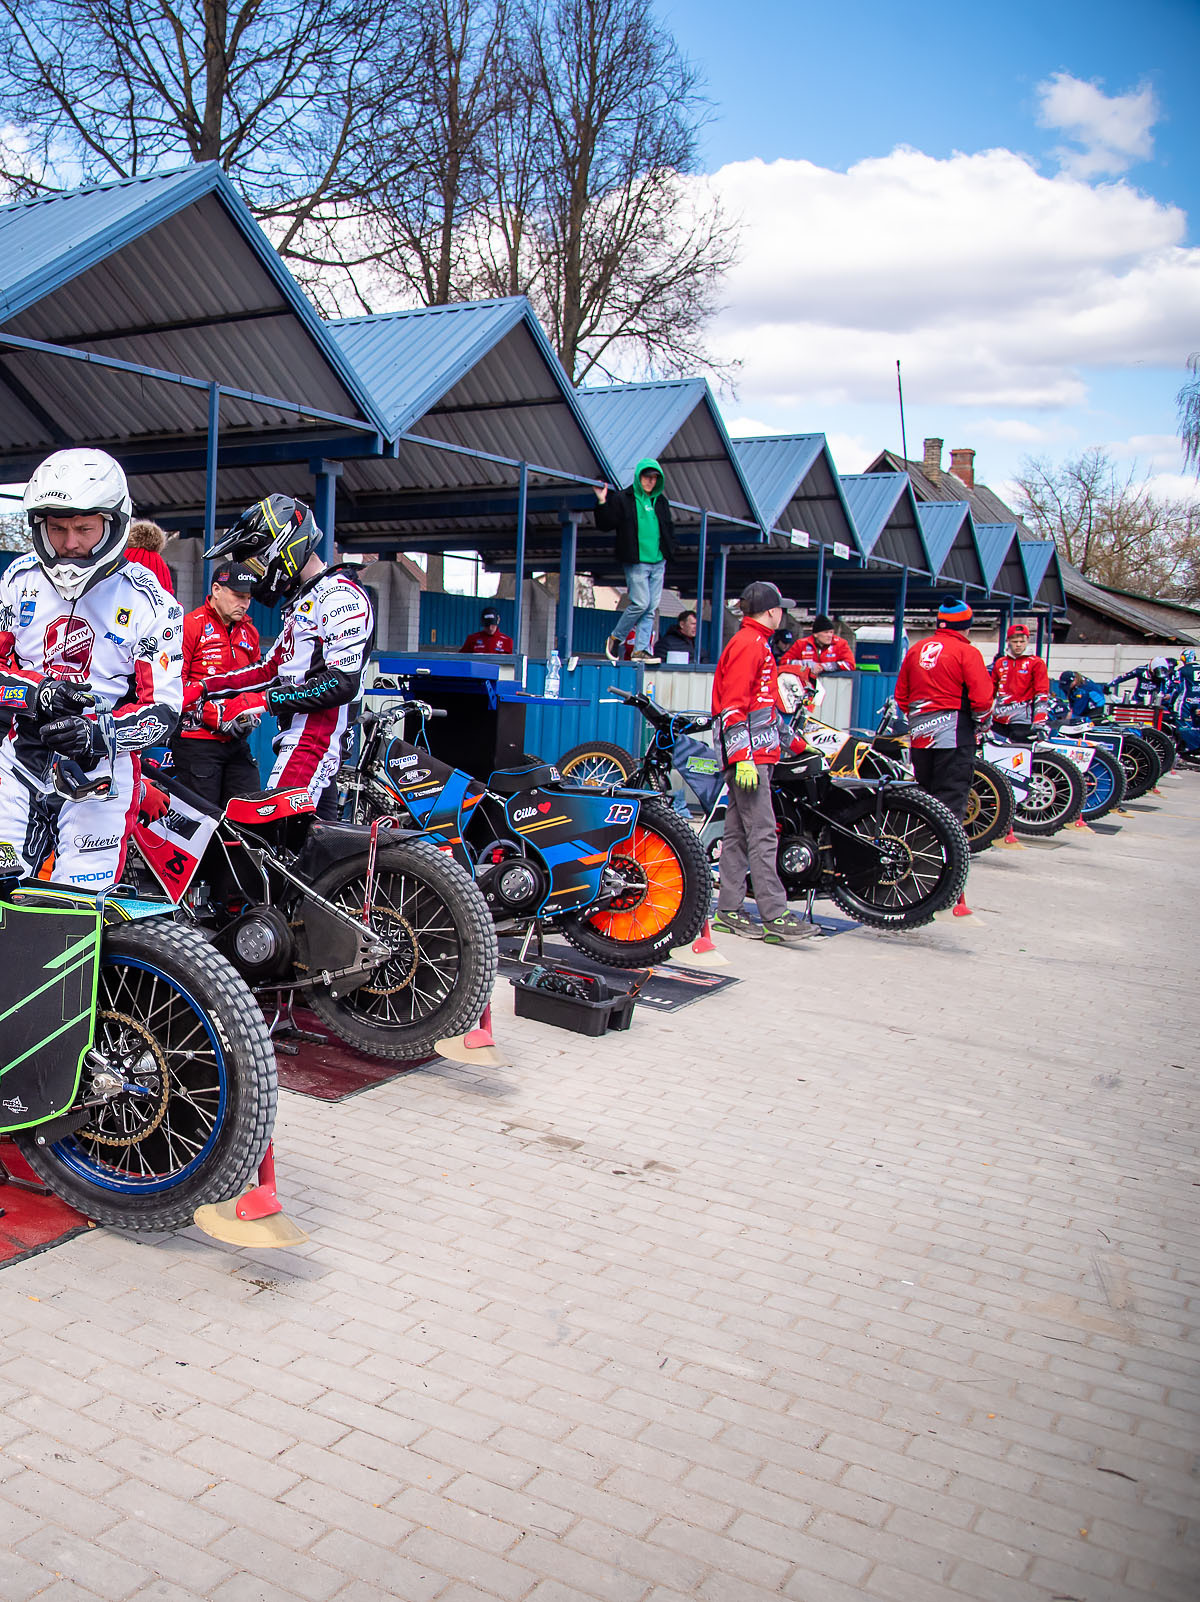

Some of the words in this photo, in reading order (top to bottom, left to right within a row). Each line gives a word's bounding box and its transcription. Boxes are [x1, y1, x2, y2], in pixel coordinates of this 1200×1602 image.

[330, 603, 360, 618] OPTIBET
[4, 688, 24, 700] LESS
[514, 806, 538, 821] Cille
[604, 804, 633, 824] 12
[74, 834, 119, 848] Interio
[69, 871, 113, 883] TRODO
